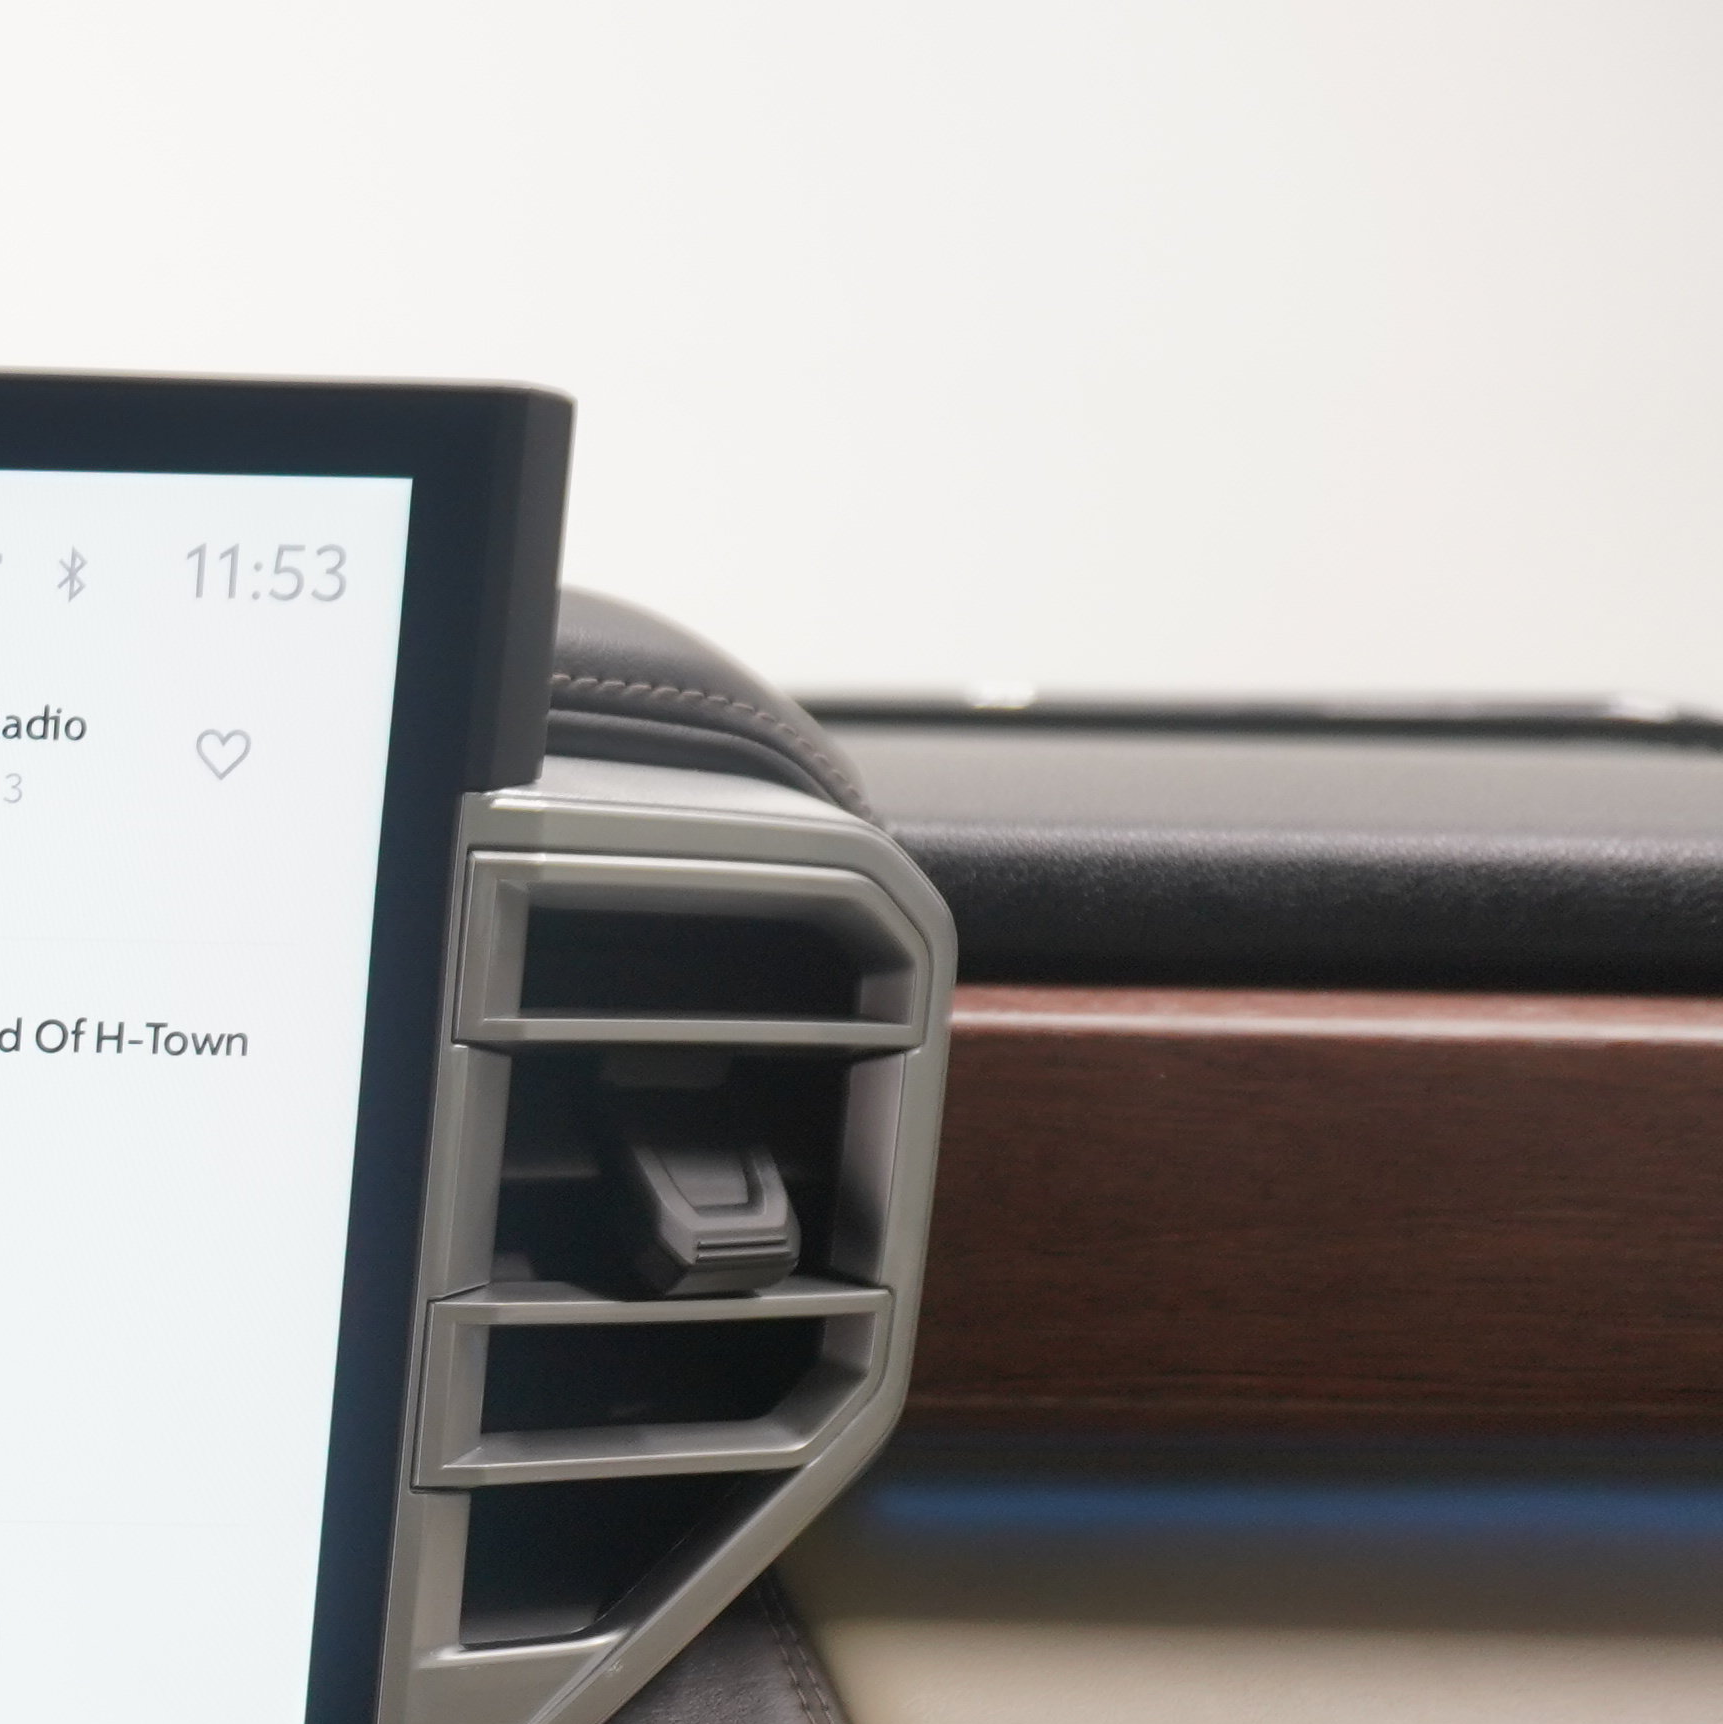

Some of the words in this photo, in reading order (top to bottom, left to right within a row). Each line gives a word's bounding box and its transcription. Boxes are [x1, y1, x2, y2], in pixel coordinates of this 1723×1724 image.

[183, 543, 347, 603] 11:53
[3, 773, 23, 803] 3
[35, 1016, 85, 1054] Of
[95, 1021, 248, 1057] H-Town
